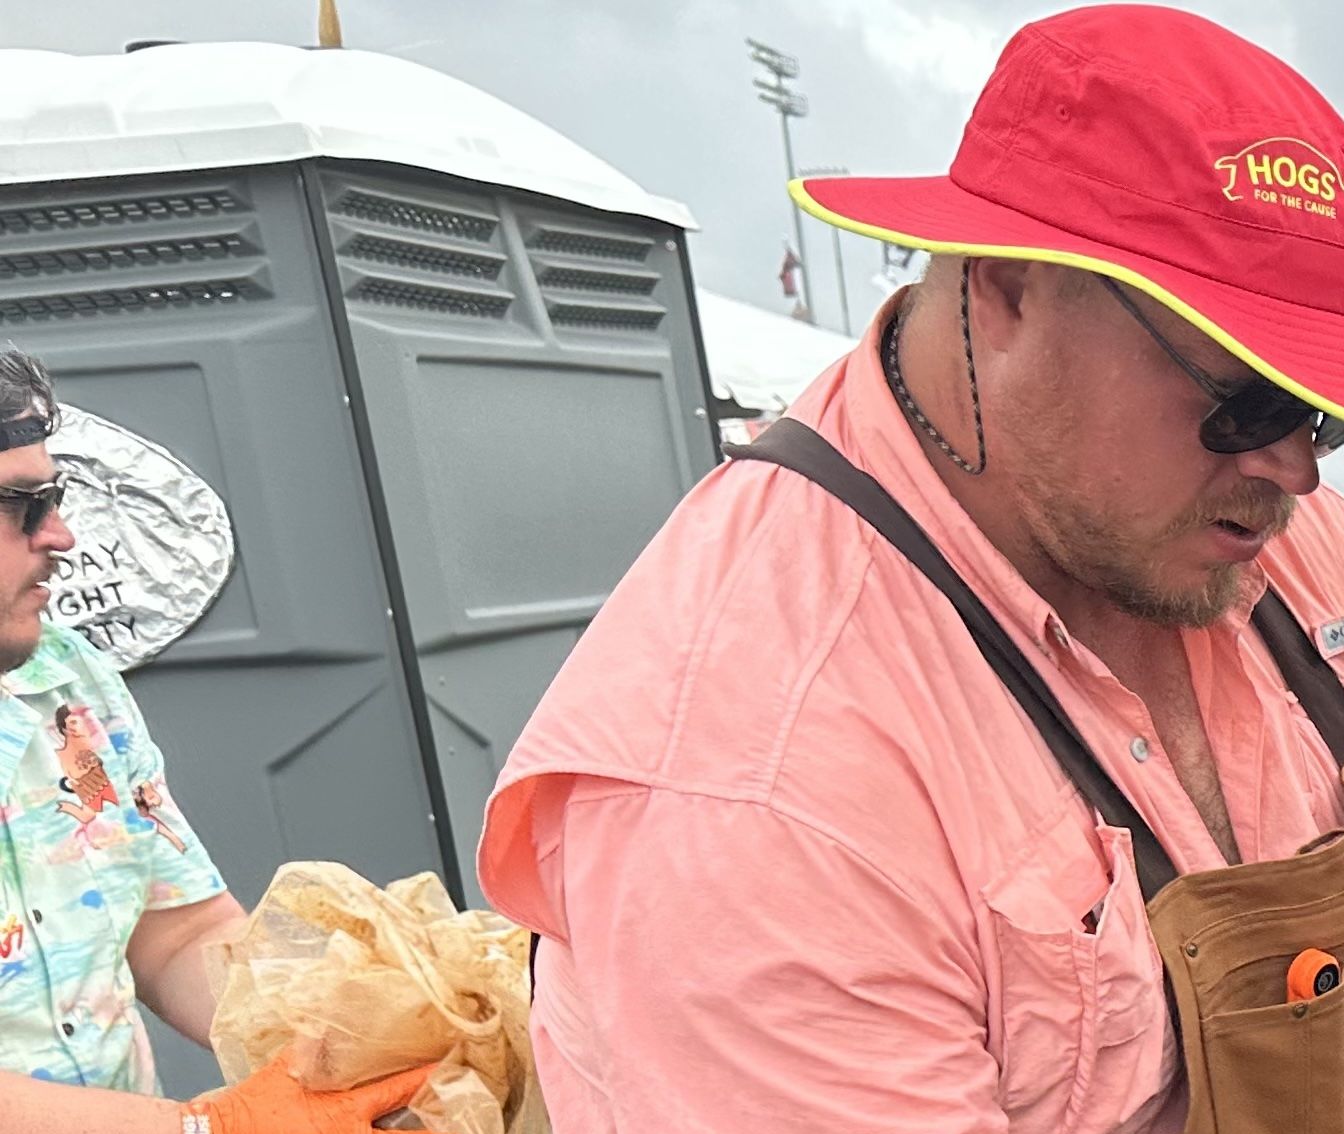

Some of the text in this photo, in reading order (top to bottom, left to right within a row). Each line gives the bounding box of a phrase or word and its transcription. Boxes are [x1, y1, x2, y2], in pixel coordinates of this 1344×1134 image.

[1247, 154, 1336, 201] HOGS
[1254, 188, 1337, 220] FOR THE CAUSE
[55, 541, 121, 581] DAY
